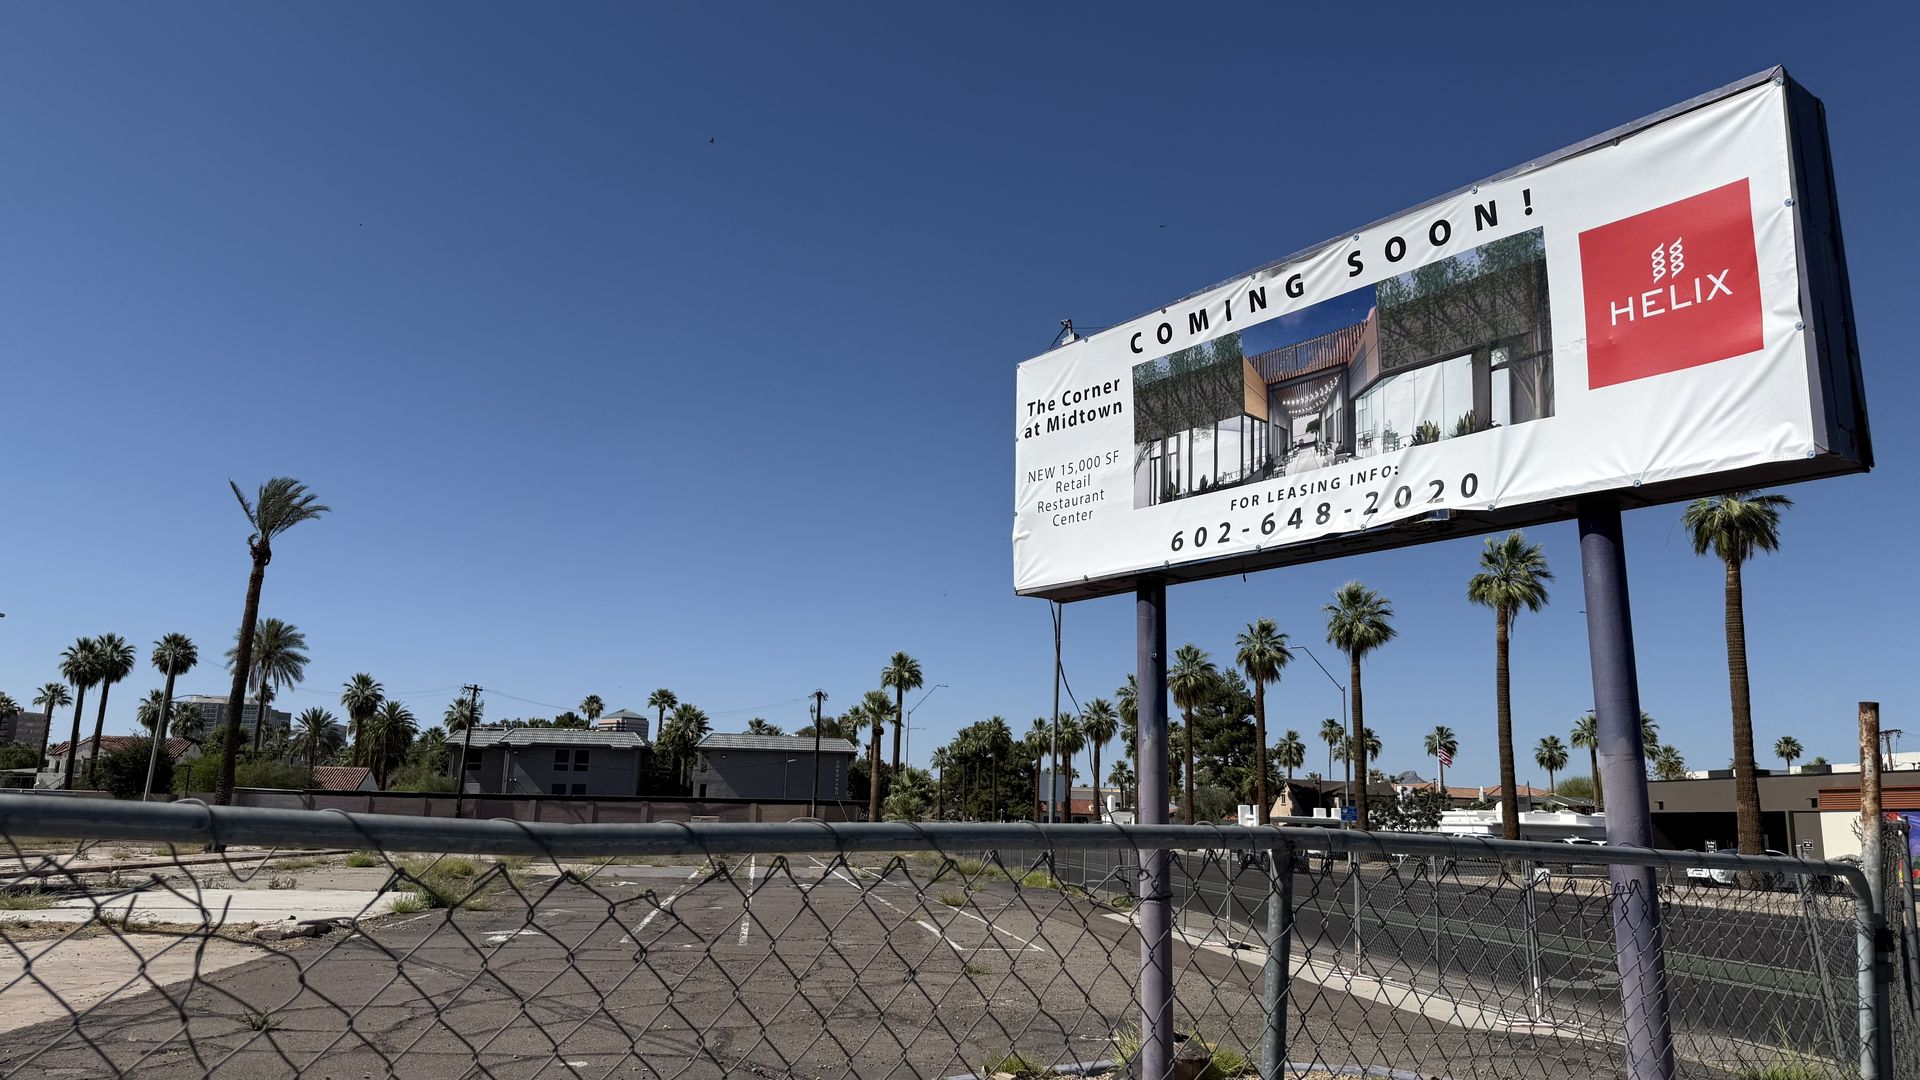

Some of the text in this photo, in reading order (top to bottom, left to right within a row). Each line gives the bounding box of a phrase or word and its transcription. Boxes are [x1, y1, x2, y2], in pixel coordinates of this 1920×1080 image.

[1130, 188, 1534, 354] COMING SOON!
[1610, 269, 1733, 326] HELIX
[1027, 378, 1122, 417] The Corner
[1024, 401, 1123, 438] at Midtown
[1028, 450, 1120, 483] NEW 15,000 SF
[1055, 474, 1091, 493] Retail
[1037, 489, 1105, 513] Restaurant
[1230, 464, 1400, 511] FOR LEASING INFO:
[1052, 509, 1094, 527] Center
[1171, 472, 1479, 552] 602-648-2020
